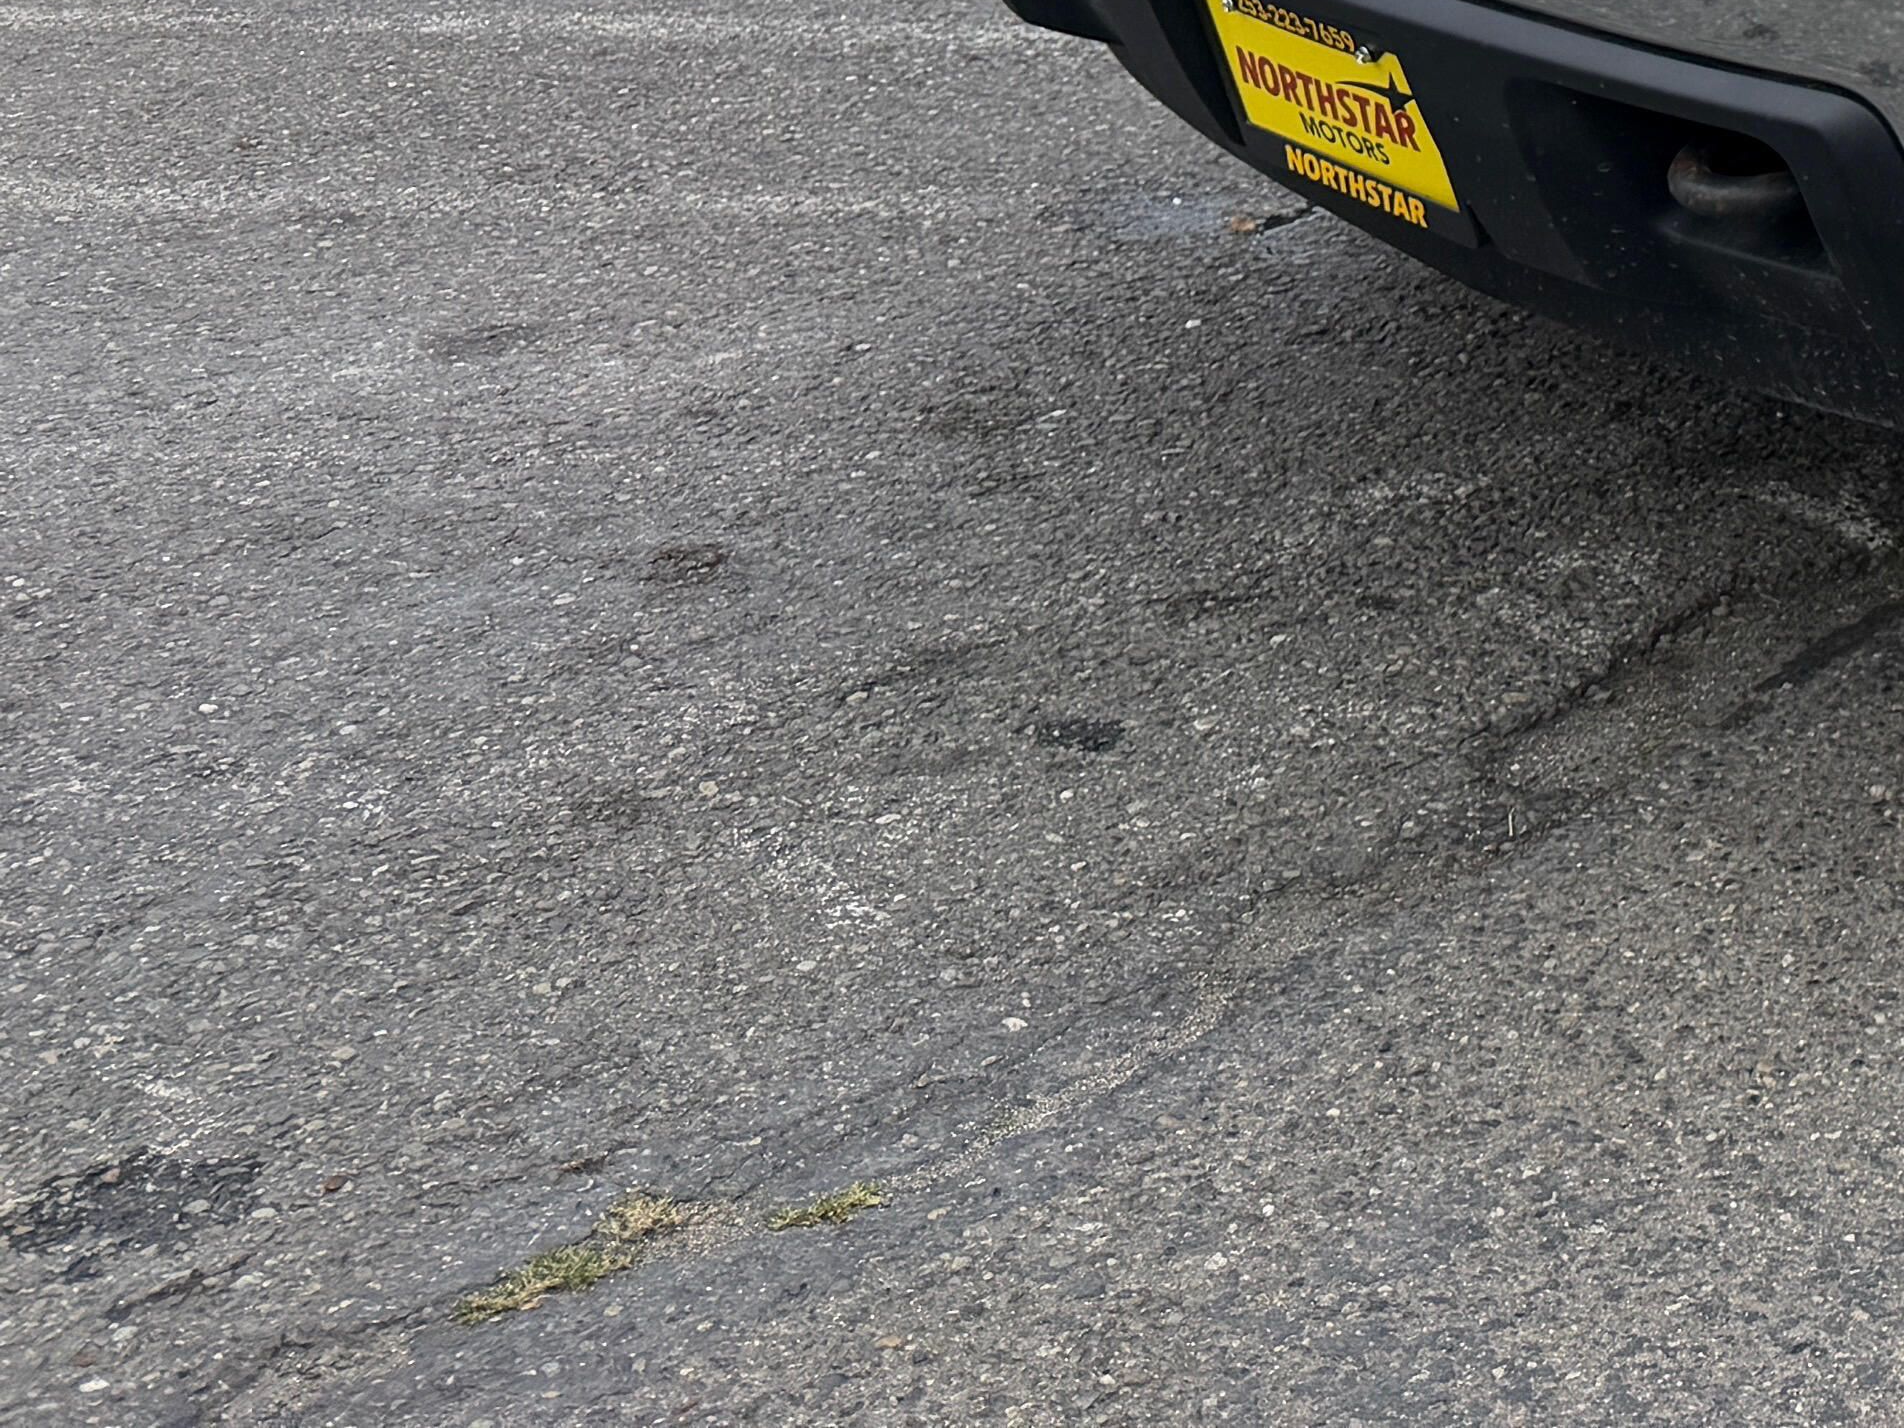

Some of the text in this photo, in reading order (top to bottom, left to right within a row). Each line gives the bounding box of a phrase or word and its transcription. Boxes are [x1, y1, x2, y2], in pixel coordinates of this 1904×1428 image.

[1235, 45, 1421, 152] NORTHSTAR
[1299, 113, 1391, 165] MOTORS
[1284, 144, 1428, 229] NORTHSTAR
